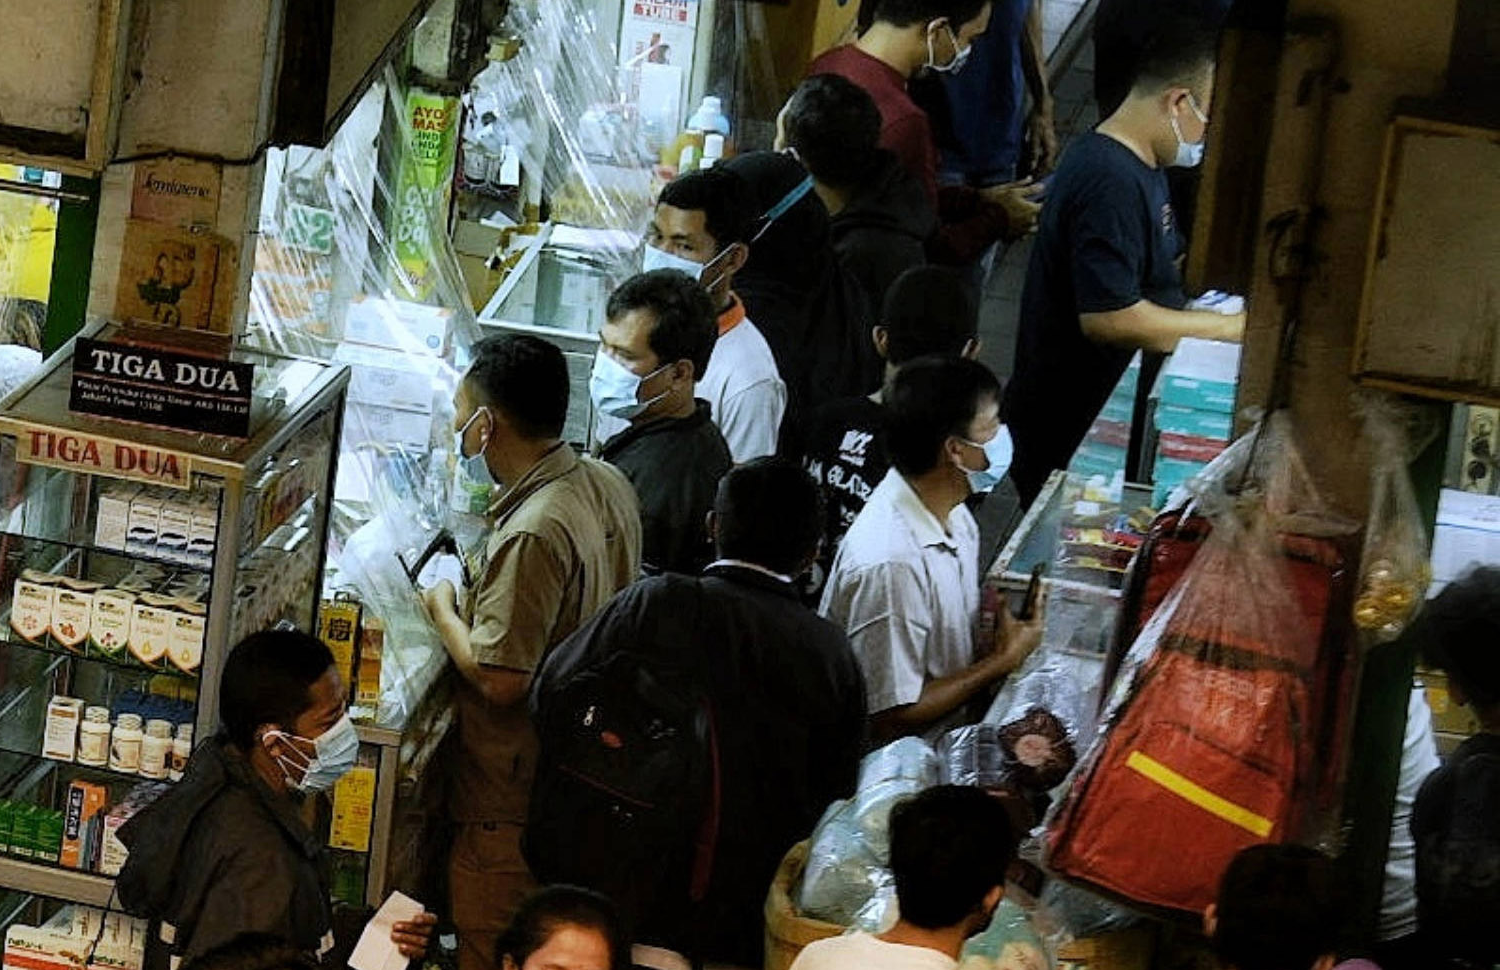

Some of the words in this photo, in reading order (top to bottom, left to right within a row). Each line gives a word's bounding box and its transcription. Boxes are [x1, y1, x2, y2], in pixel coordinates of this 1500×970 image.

[91, 349, 165, 381] TIGA
[174, 363, 240, 392] DUA
[27, 430, 101, 467] TIGA
[114, 443, 181, 480] DUA
